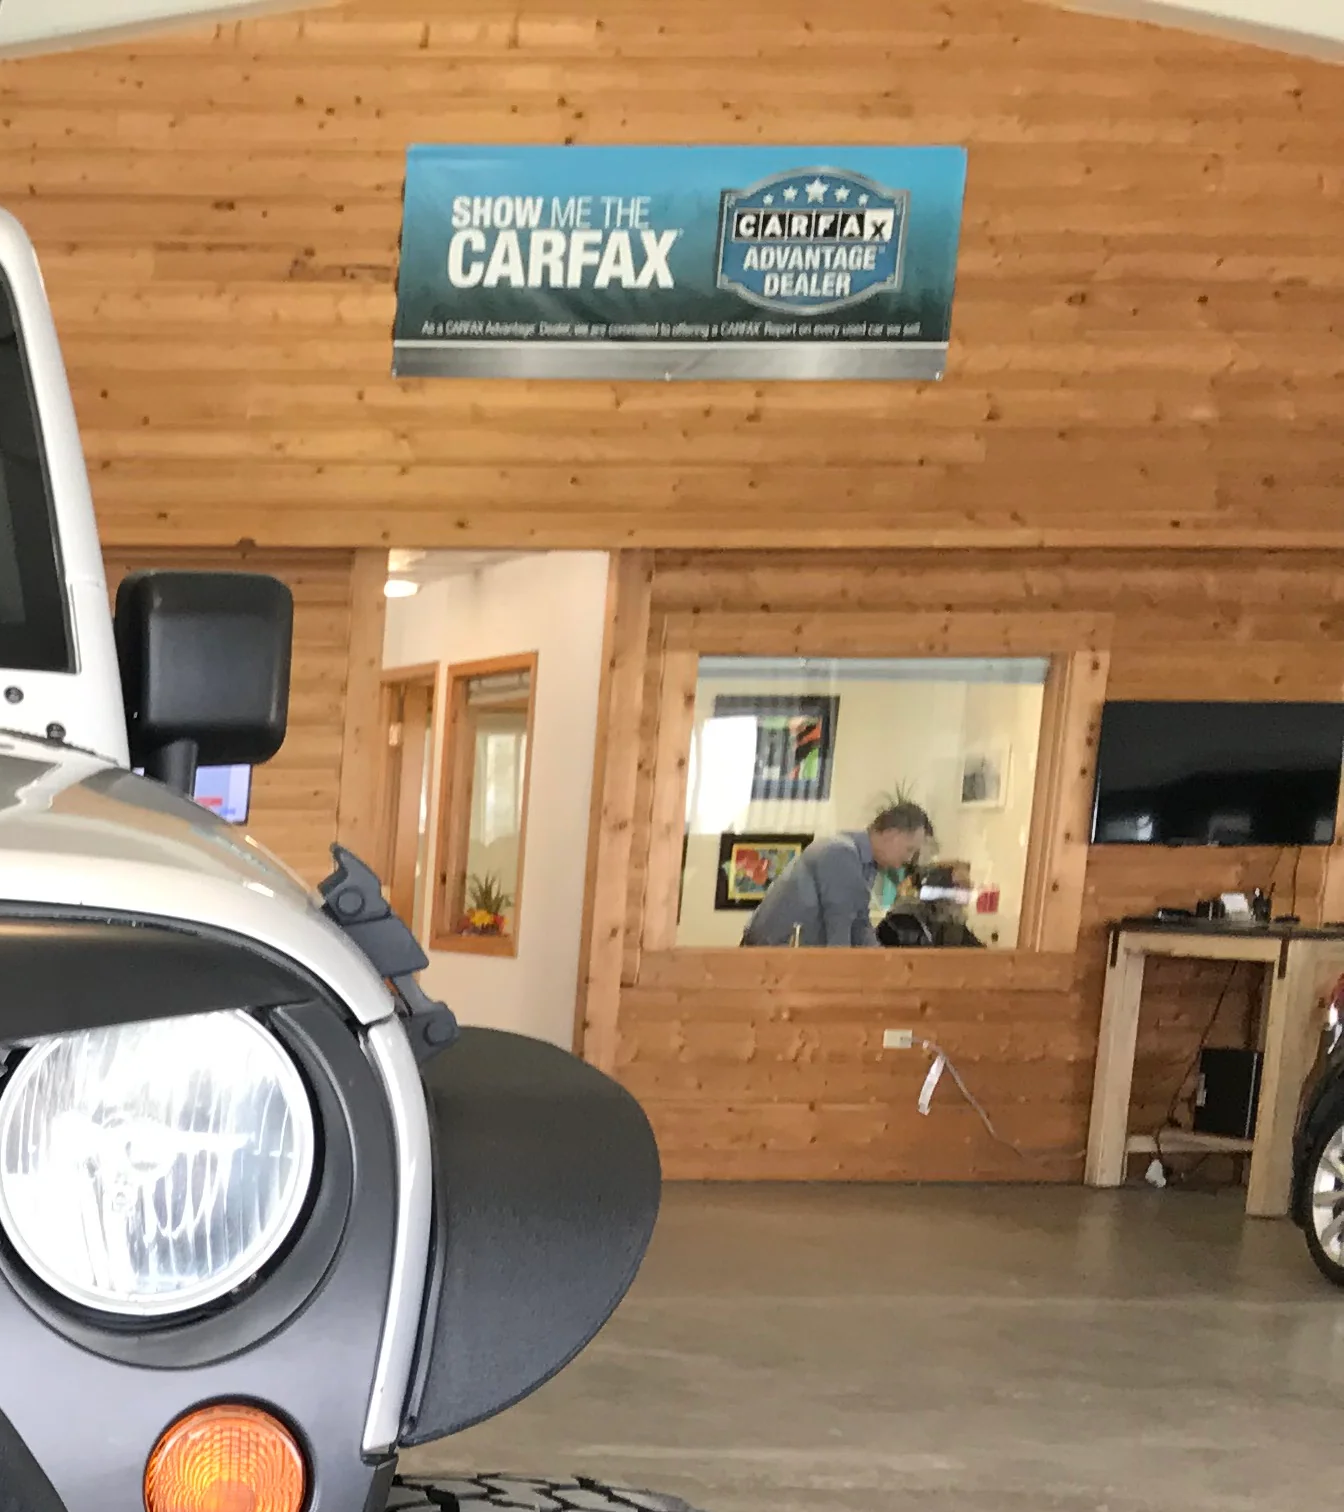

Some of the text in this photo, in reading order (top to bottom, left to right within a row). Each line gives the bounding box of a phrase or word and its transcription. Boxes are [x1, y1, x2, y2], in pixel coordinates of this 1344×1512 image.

[451, 195, 651, 229] SHOW ME THE
[736, 212, 889, 241] CARFAX
[447, 228, 679, 289] CARFAX
[743, 245, 878, 272] ADVANTAGE
[763, 272, 851, 297] DEALER
